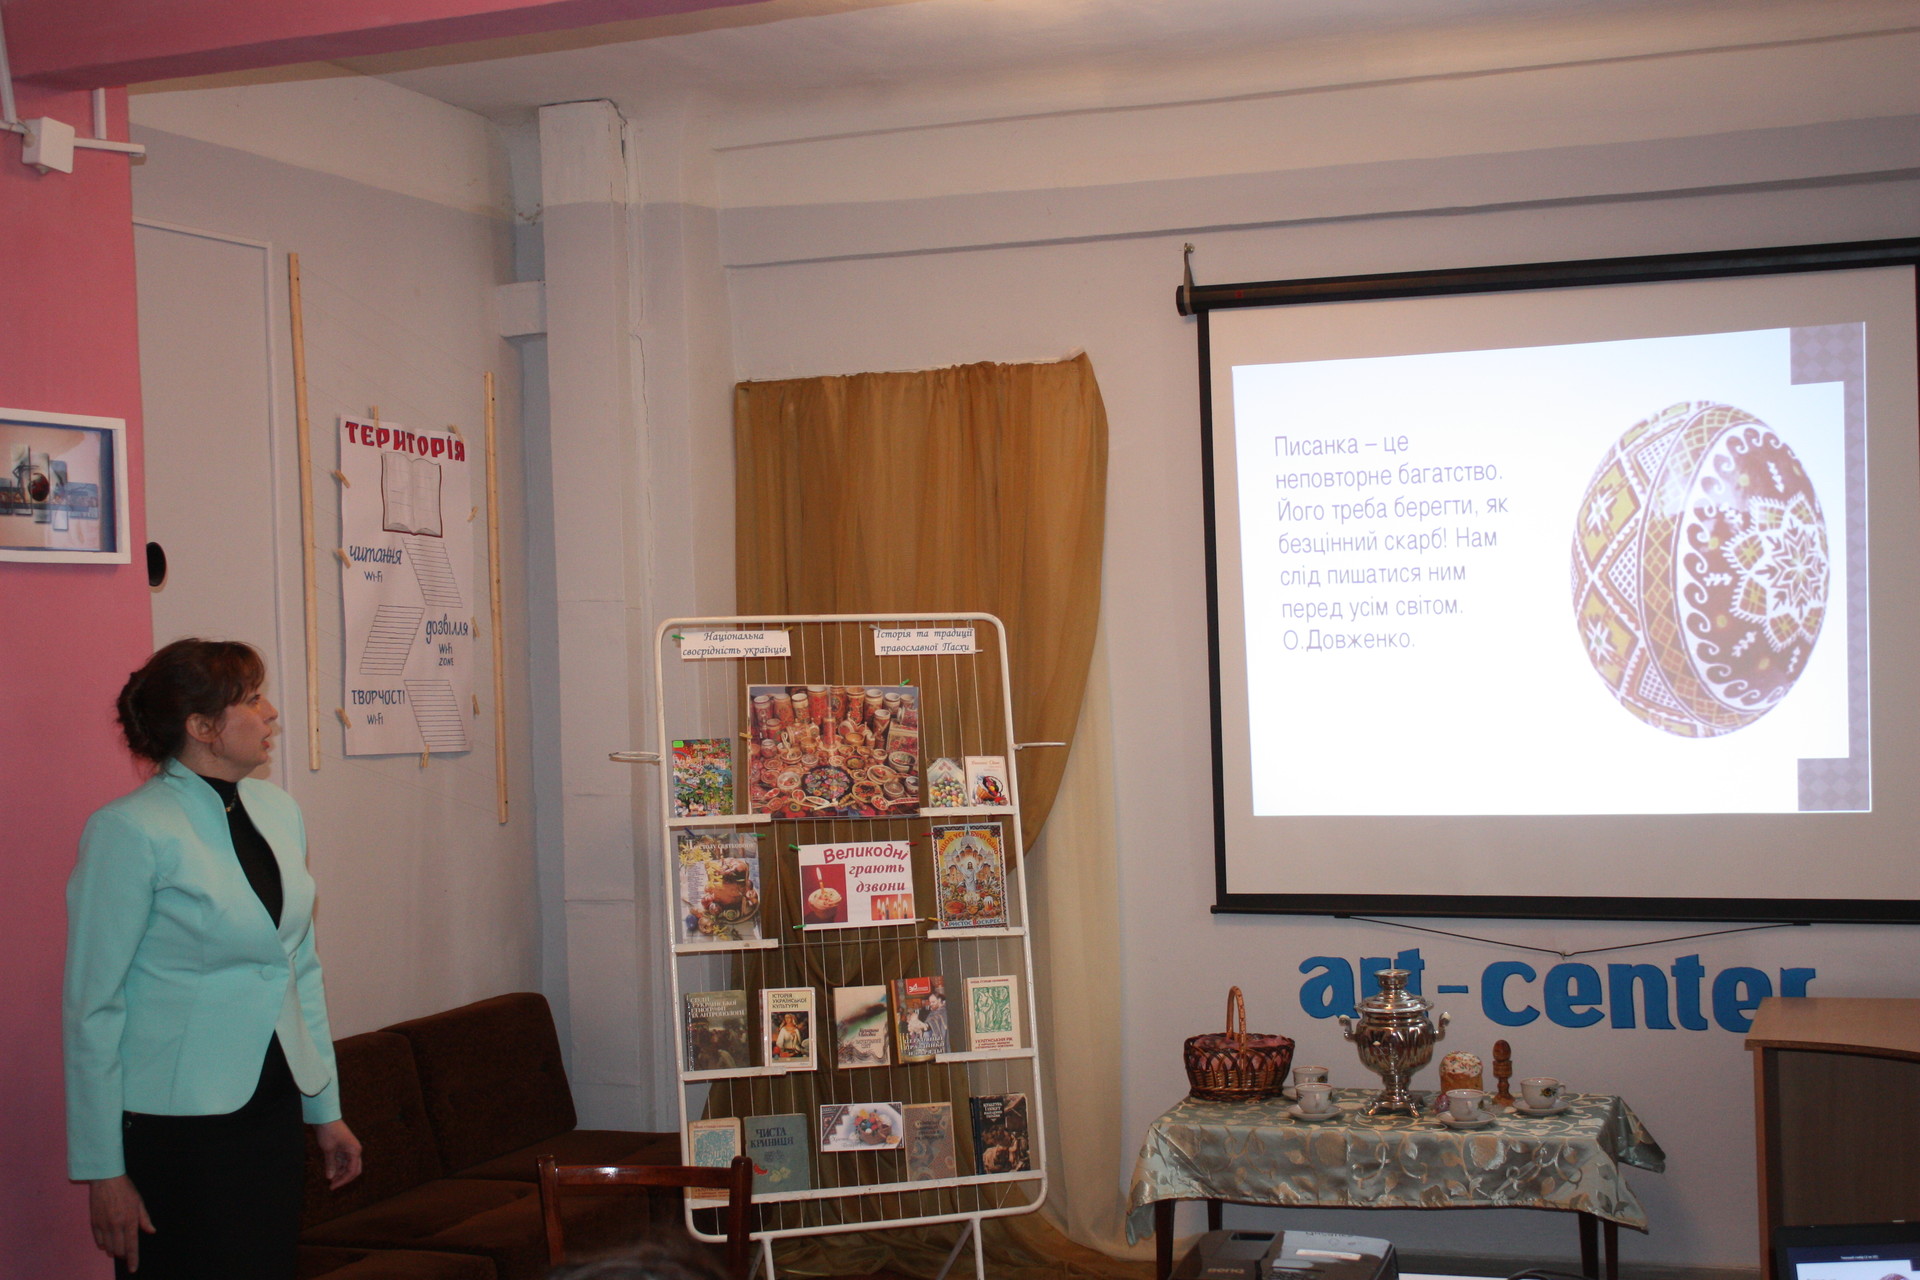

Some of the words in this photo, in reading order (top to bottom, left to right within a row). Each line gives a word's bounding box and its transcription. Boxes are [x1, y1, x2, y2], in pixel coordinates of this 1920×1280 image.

[345, 421, 465, 462] ТЕРИТОРІЯ
[1275, 435, 1359, 457] Писанка
[1384, 435, 1409, 454] це
[1276, 469, 1392, 491] неповторне
[1399, 462, 1503, 485] багатство.
[1278, 497, 1324, 521] Його
[1332, 496, 1387, 525] треба
[1394, 496, 1478, 522] берегти,
[1486, 497, 1508, 514] як
[1279, 530, 1378, 556] безцінний
[1385, 527, 1447, 554] скарб!
[1456, 526, 1497, 548] Нам
[1280, 564, 1321, 588] слід
[1328, 566, 1421, 584] пишатися
[1429, 565, 1465, 581] ним
[1282, 601, 1343, 623] перед
[1350, 595, 1388, 622] усім
[1396, 594, 1463, 616] світом.
[704, 631, 764, 642] Національна
[876, 629, 911, 641] Історія
[916, 630, 929, 638] та
[934, 628, 973, 640] традиції
[682, 645, 741, 658] своєрідність
[743, 645, 787, 657] українців
[880, 643, 938, 655] православної
[942, 642, 970, 652] Пасхи
[351, 689, 405, 705] ТВОРЧОСТІ
[823, 843, 909, 864] Великодні
[849, 864, 905, 878] грають
[856, 881, 905, 893] дзвони
[756, 1127, 786, 1138] ЧИСТА
[751, 1137, 794, 1148] КРИНИЦЯ
